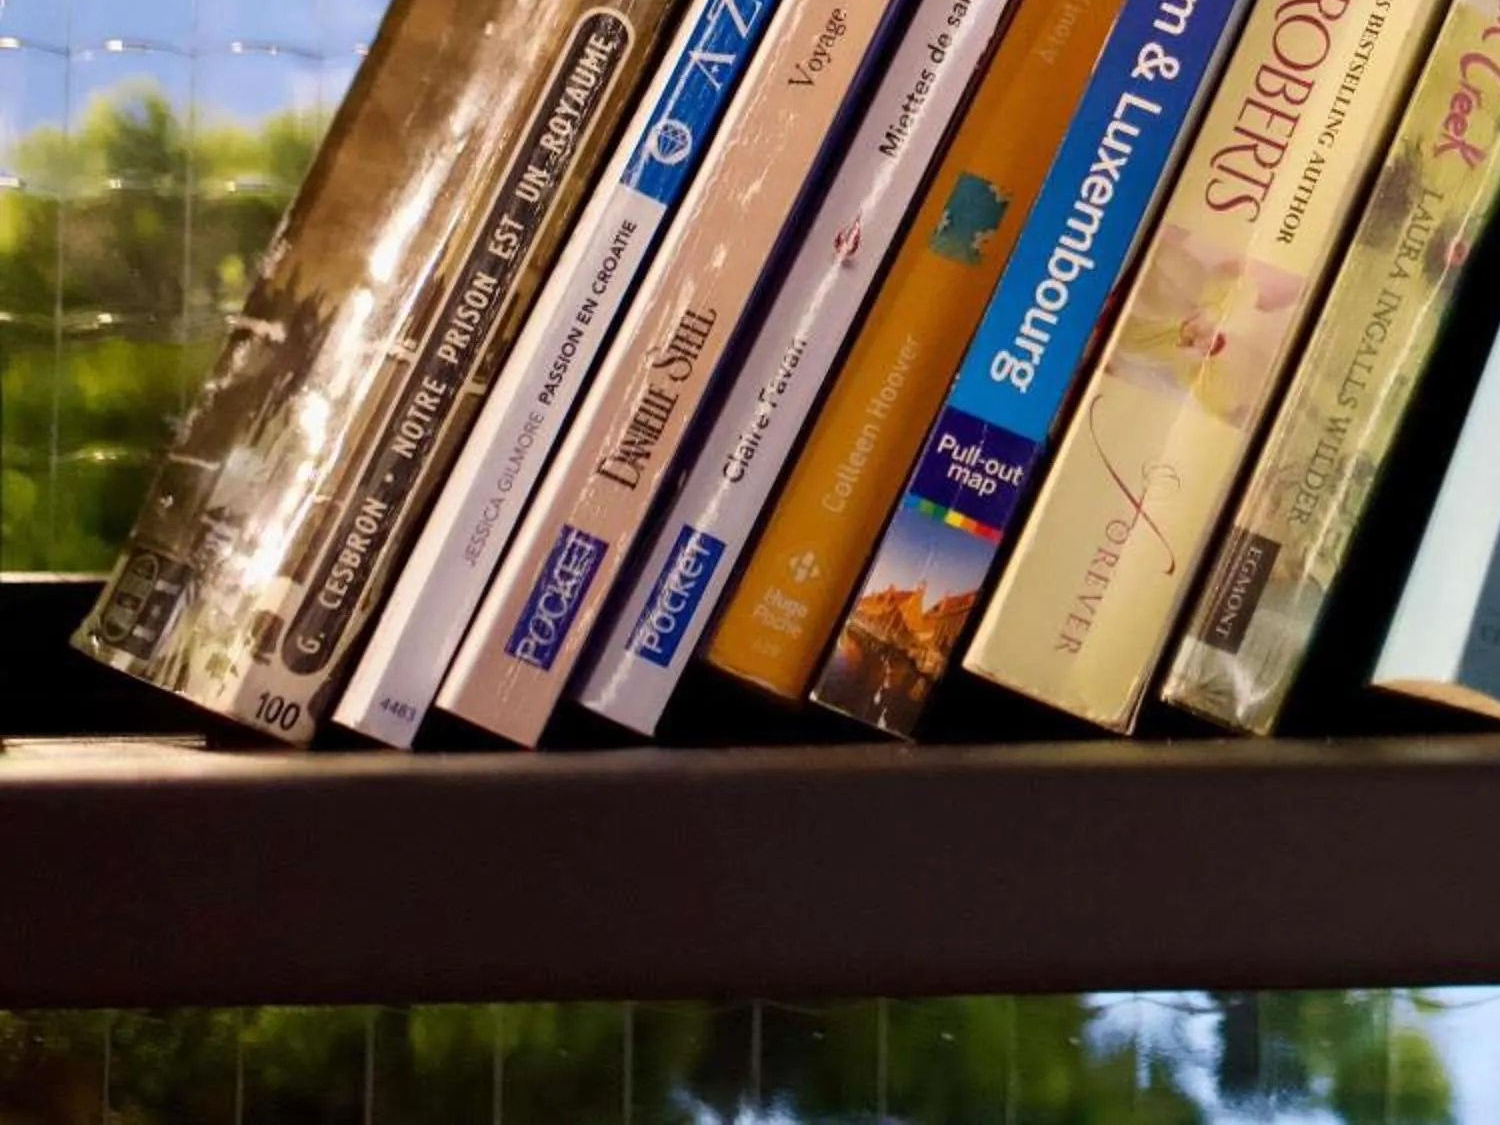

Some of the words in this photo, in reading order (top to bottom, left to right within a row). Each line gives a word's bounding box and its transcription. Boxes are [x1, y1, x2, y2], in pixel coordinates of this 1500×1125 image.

[788, 6, 848, 88] Voyage
[878, 70, 937, 160] Miettes
[928, 32, 952, 65] de
[1131, 42, 1181, 81] &
[1317, 12, 1387, 149] BESTSELLING
[989, 91, 1163, 395] Luxembourg
[1276, 151, 1326, 245] AUTHOR
[1388, 187, 1445, 287] LAURA
[319, 497, 388, 610] CESBRON
[391, 375, 447, 459] NOTRE
[438, 271, 498, 365] PRISON
[489, 214, 525, 261] EST
[515, 165, 549, 203] UN
[540, 32, 617, 153] ROYAUME
[1337, 285, 1405, 410] INGALLS
[464, 496, 505, 567] JESSICA
[497, 411, 545, 493] GILMORE
[539, 326, 584, 405] PASSION
[576, 298, 599, 324] EN
[591, 219, 639, 296] CROATIE
[596, 383, 681, 490] DANIELLE
[653, 307, 718, 383] STEEL
[722, 414, 770, 484] Claire
[821, 426, 876, 514] Colleen
[866, 335, 921, 425] Hoover
[936, 433, 1024, 488] Pull-out
[946, 462, 997, 497] map
[1287, 407, 1350, 525] WILDER
[515, 527, 595, 666] POCKET
[1214, 544, 1264, 638] EGMONT
[254, 692, 301, 732] 100
